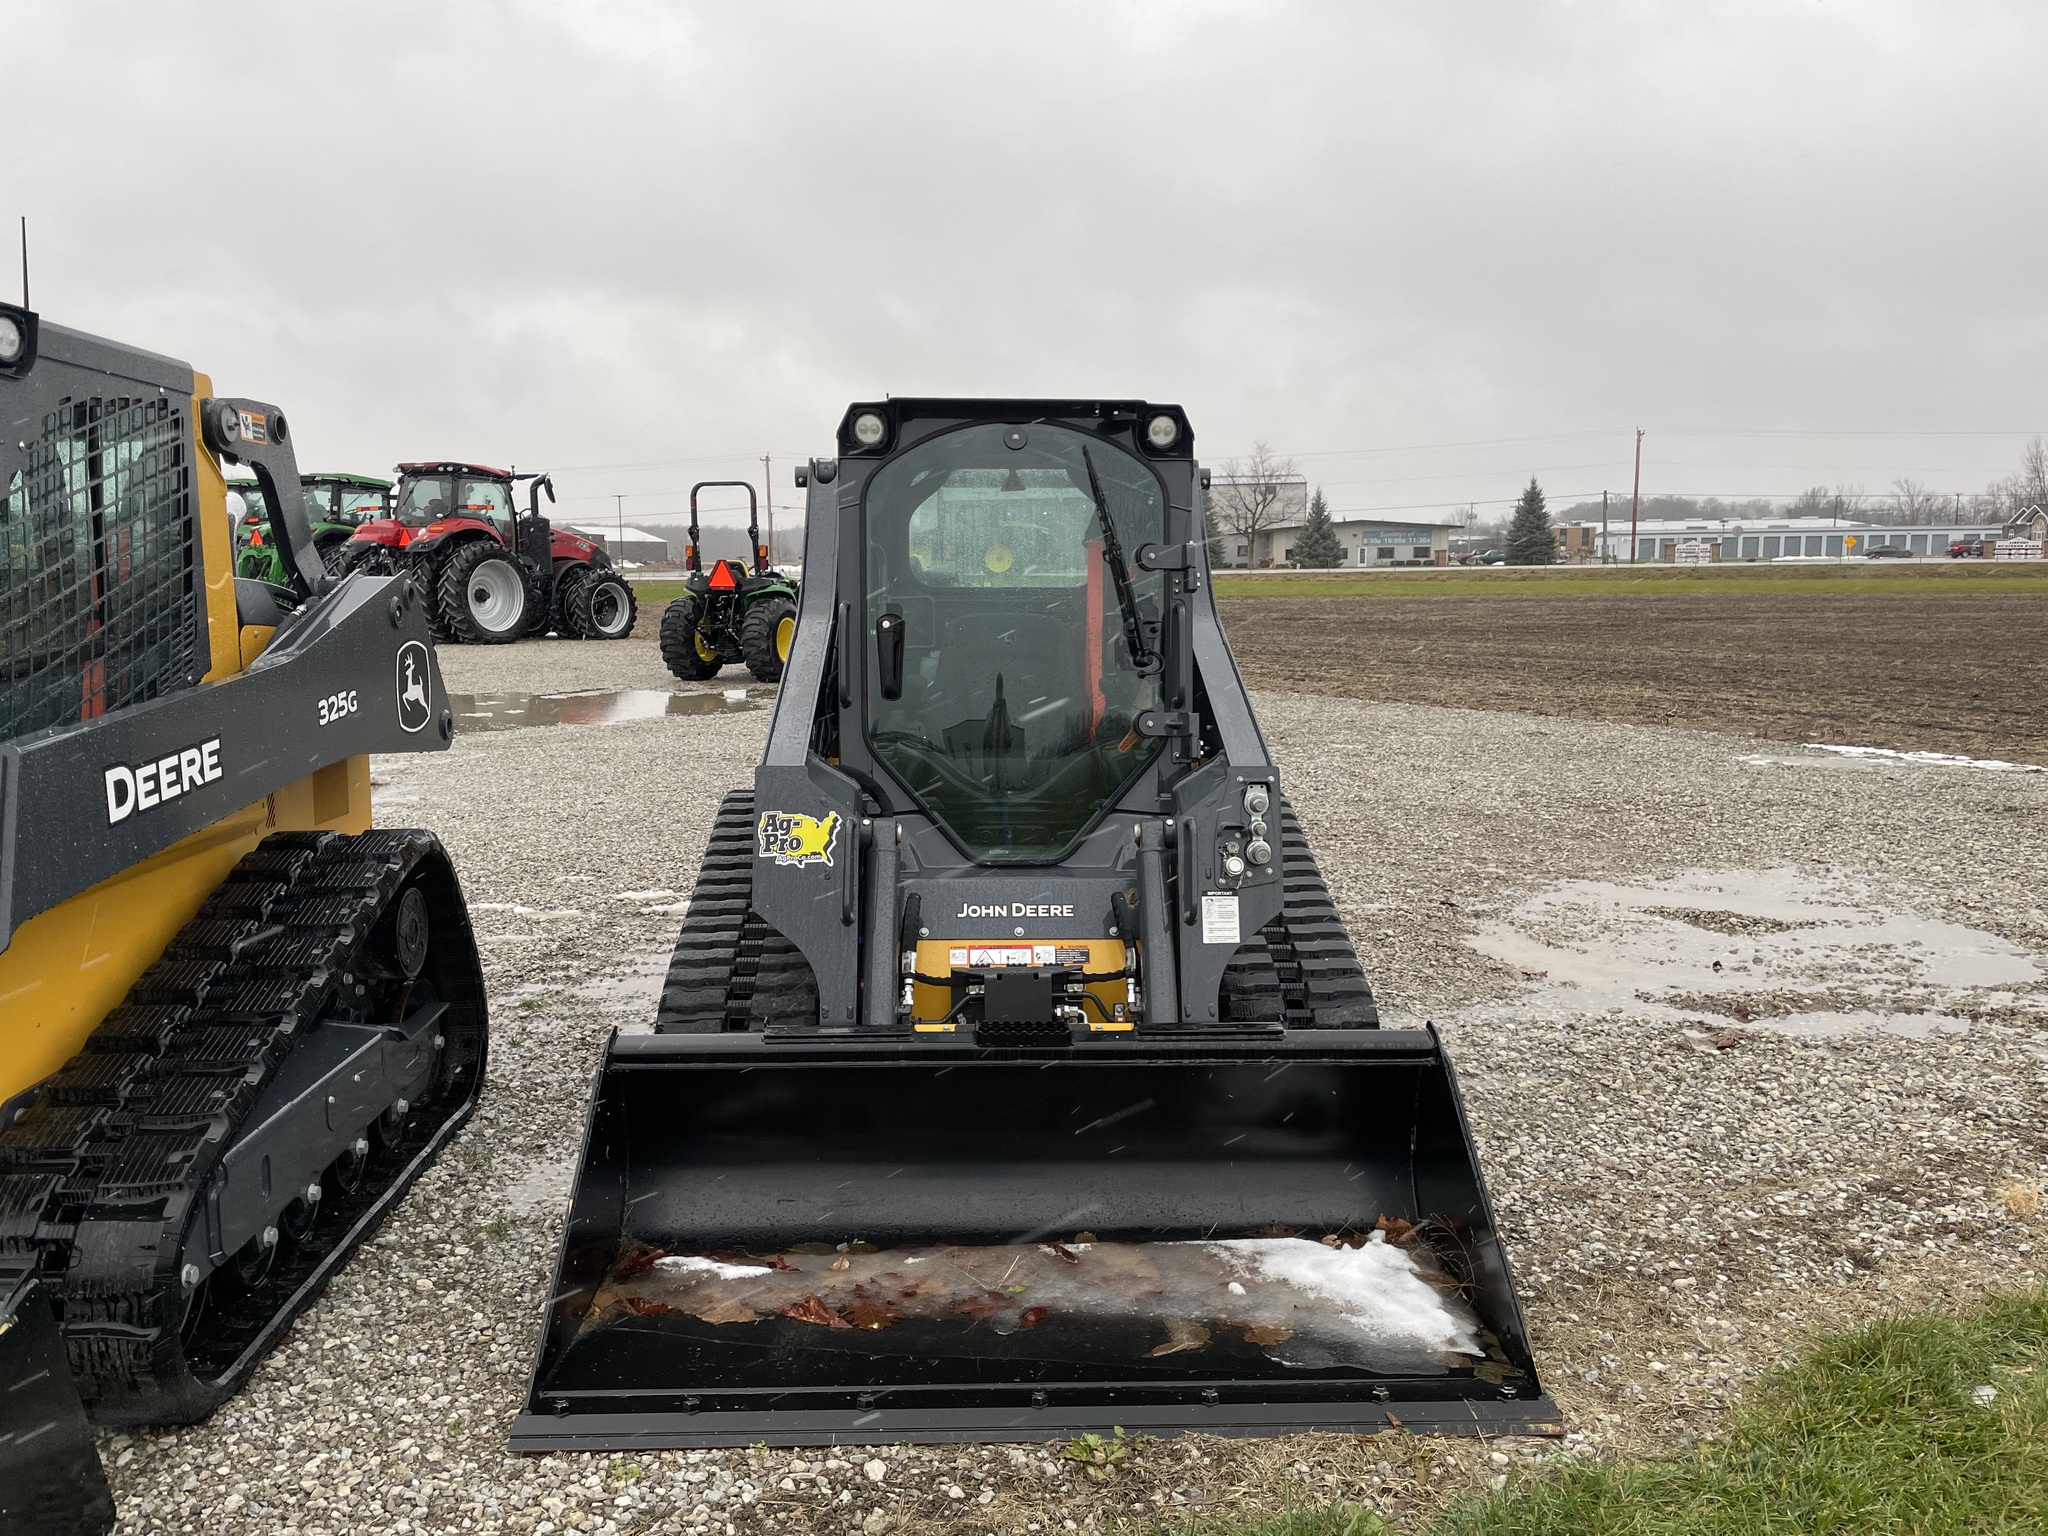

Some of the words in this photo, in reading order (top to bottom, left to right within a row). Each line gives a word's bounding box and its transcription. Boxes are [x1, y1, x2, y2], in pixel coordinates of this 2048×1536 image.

[317, 690, 358, 727] 325G
[105, 738, 223, 824] DEERE
[762, 814, 801, 836] Ag-
[762, 833, 802, 853] Pro
[777, 854, 823, 862] AgProCo.com
[957, 903, 1007, 917] JOHN
[1011, 902, 1074, 917] DEERE
